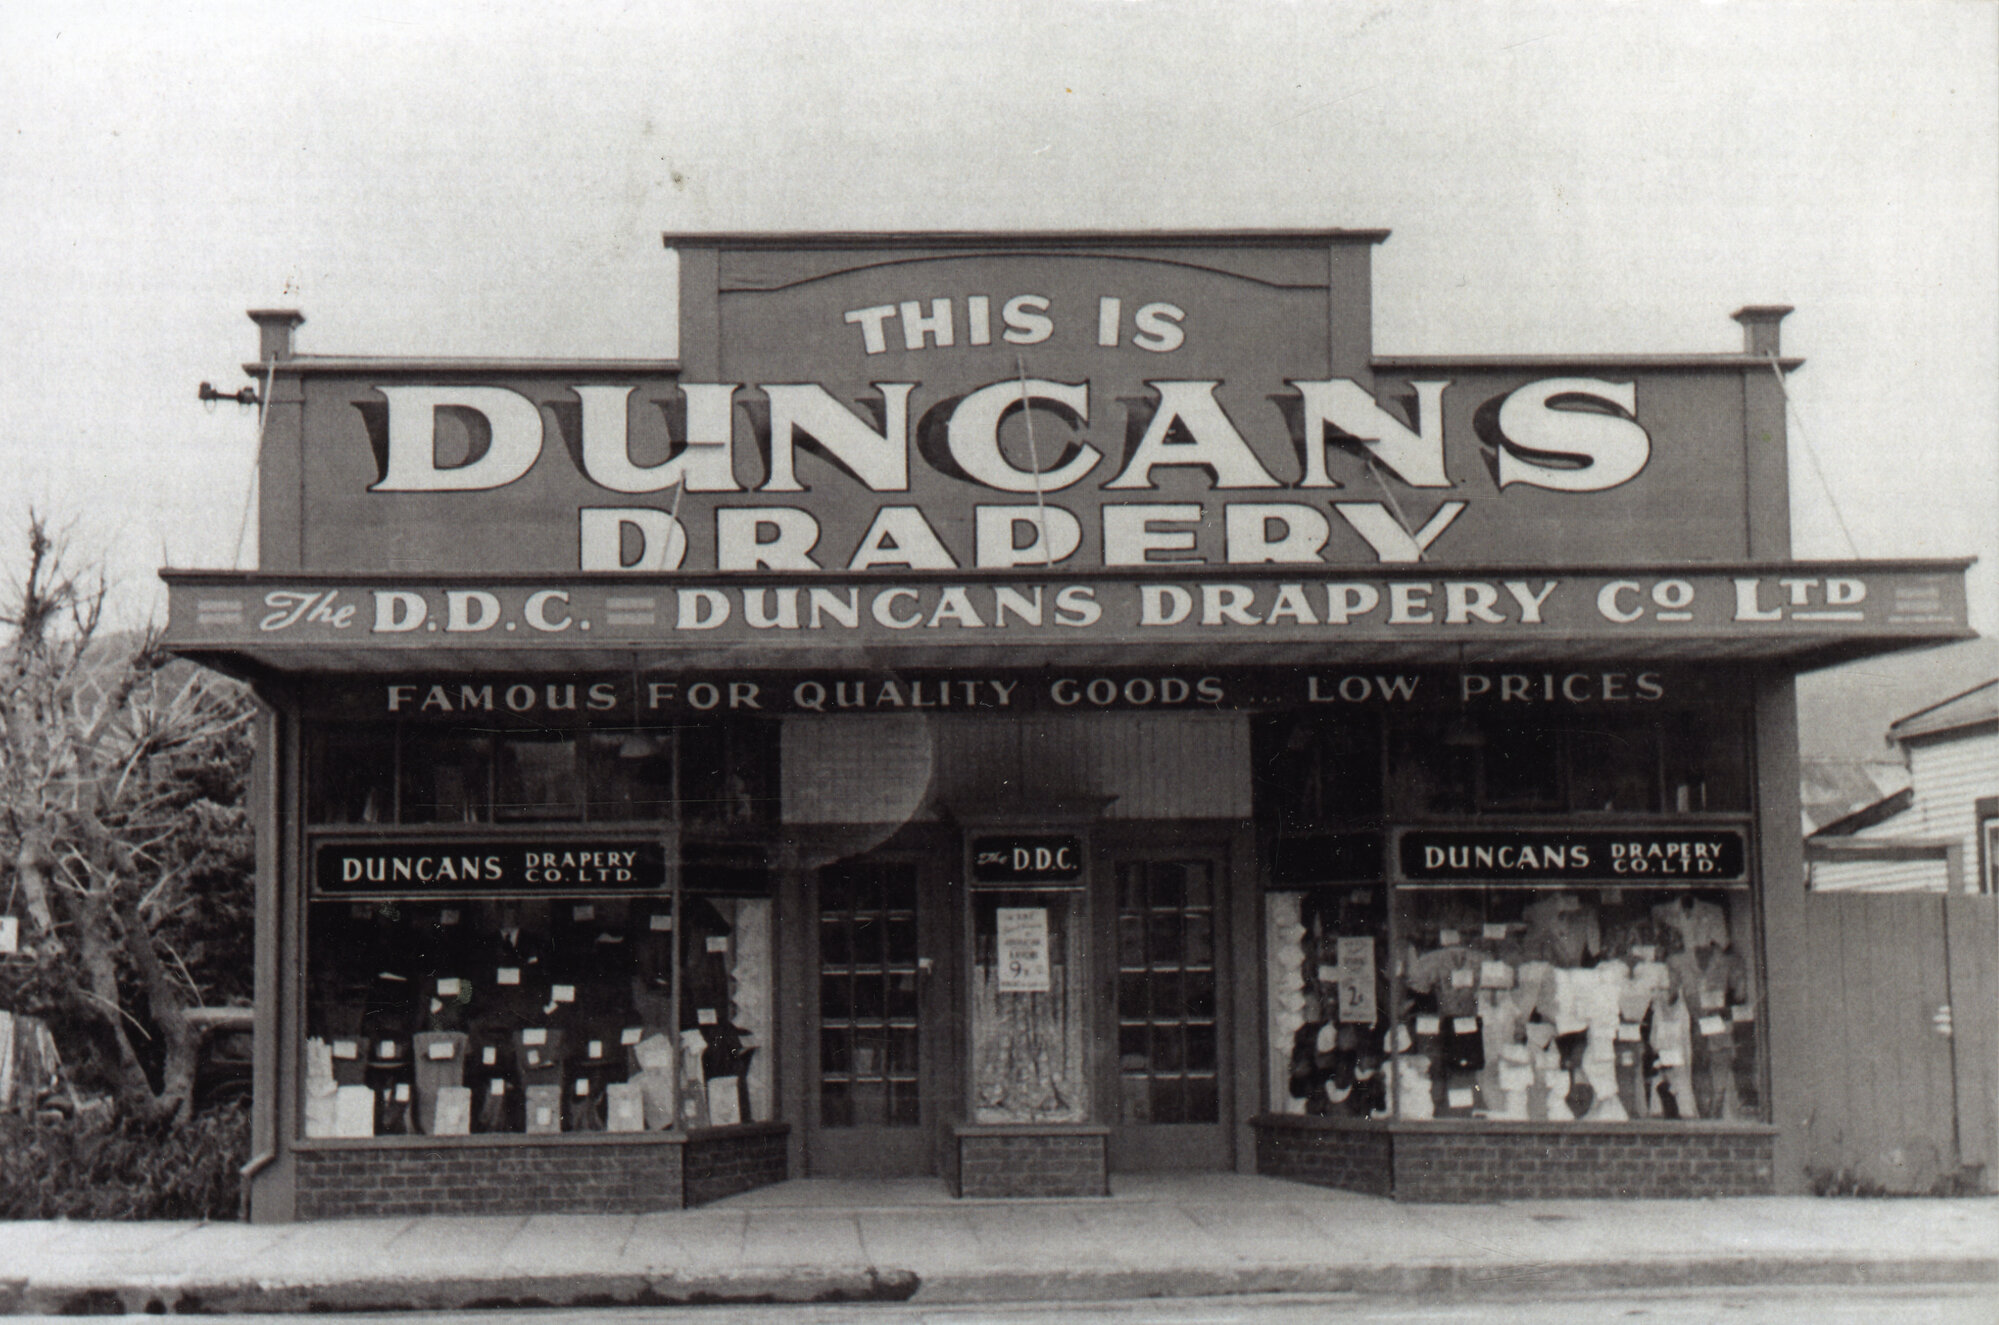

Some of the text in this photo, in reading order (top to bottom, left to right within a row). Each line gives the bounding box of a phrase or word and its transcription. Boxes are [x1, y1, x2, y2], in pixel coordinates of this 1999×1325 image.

[844, 295, 1187, 354] THIS IS
[368, 376, 1651, 494] DUNCANS
[580, 502, 1464, 571] DRAPERY
[260, 589, 356, 631] The
[371, 589, 591, 633] D.D.C.
[675, 586, 1101, 630] DUNCANS
[1138, 580, 1558, 626] DRAPERY
[387, 672, 1664, 712] FAMOUS FOR QUALITY GOODS LOW PRICES
[525, 851, 637, 868] DRAPERY
[1013, 846, 1078, 871] D.D.C.
[1424, 846, 1590, 869] DUNCANS
[1611, 843, 1723, 858] DRAPERY
[342, 856, 502, 882] DUNCANS
